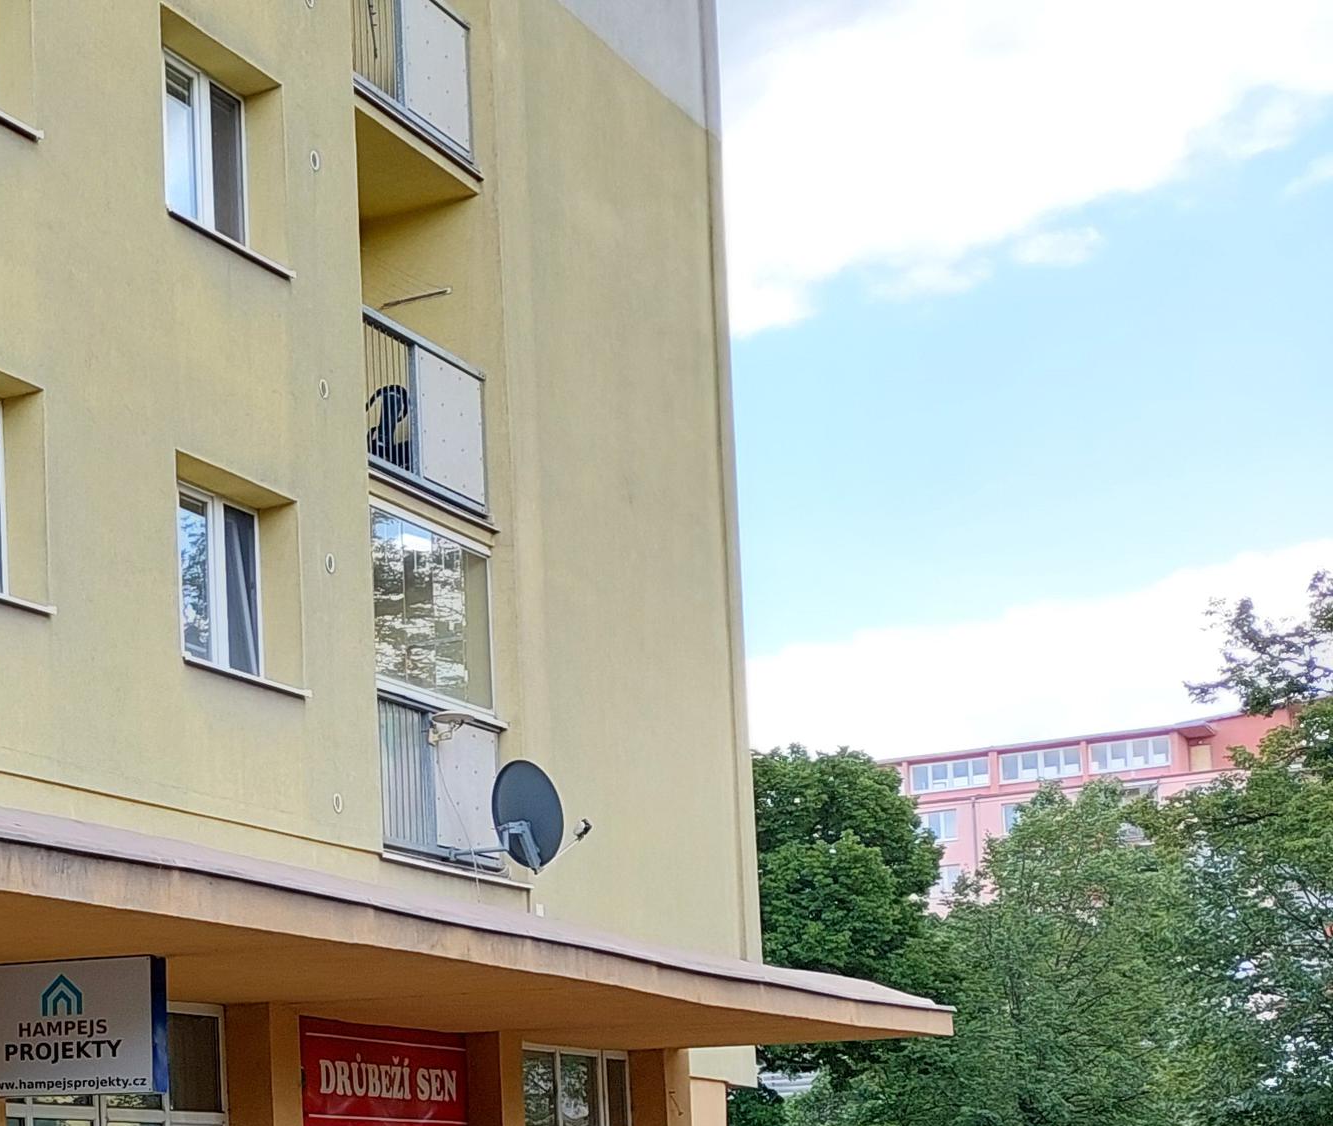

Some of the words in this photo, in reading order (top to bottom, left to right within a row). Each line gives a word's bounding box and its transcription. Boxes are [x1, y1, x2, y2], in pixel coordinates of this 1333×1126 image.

[18, 1018, 108, 1038] HAMPEJS
[5, 1039, 122, 1064] PROJEKTY
[319, 1053, 412, 1100] DRŮBEŽÍ
[416, 1068, 457, 1102] SEN
